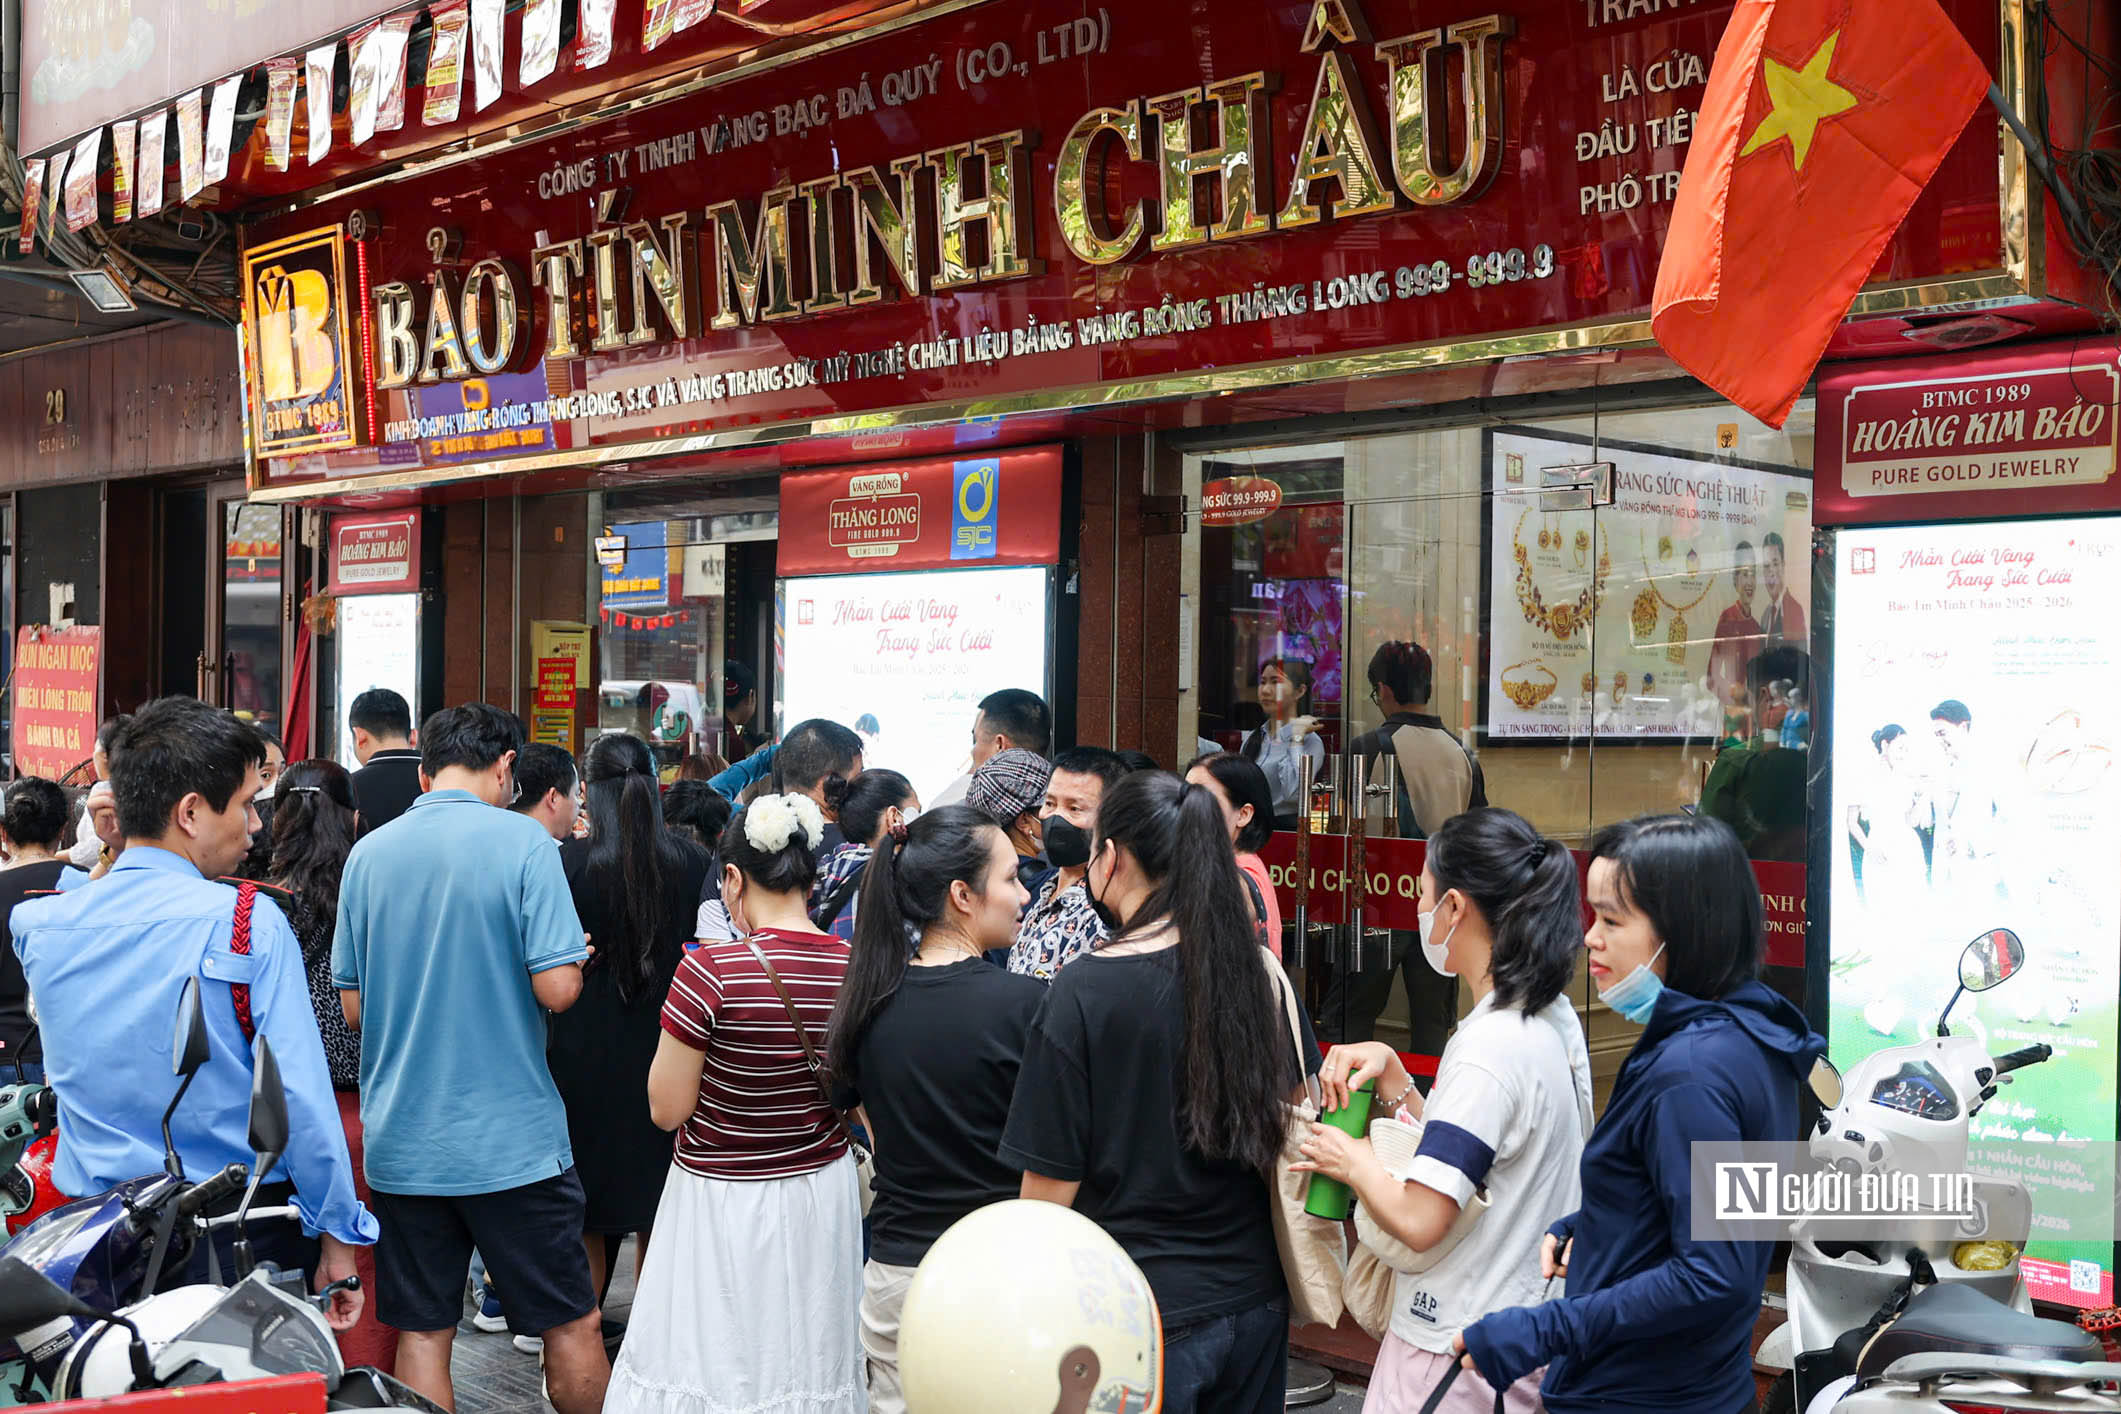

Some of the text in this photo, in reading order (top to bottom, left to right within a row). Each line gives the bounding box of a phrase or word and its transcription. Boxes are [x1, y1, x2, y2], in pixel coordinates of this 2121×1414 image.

[1602, 49, 1706, 104] LÀ CỬA
[538, 158, 596, 200] CÔNG
[602, 149, 631, 183] TY
[635, 131, 696, 173] TNHH
[700, 111, 769, 155] VÀNG
[775, 94, 829, 139] BẠC
[836, 72, 876, 120] ĐÁ
[881, 53, 943, 106] QUÝ
[1037, 7, 1111, 65] LTD)
[1575, 117, 1635, 162] ĐẦU
[372, 0, 1501, 390] BẢO TÍN MINH CHÂU
[1580, 169, 1642, 216] PHỐ
[384, 422, 410, 443] KINH
[411, 414, 454, 439] DOANH
[657, 377, 679, 407] VÀ
[726, 365, 784, 398] TRANG
[854, 341, 906, 380] NGHỆ
[908, 330, 961, 370] CHẤT
[964, 326, 1009, 367] LIỆU
[1012, 313, 1073, 357] BẰNG
[1077, 305, 1140, 347] VÀNG
[1143, 293, 1212, 337] RỒNG
[1216, 281, 1307, 326] THĂNG
[1312, 271, 1390, 313] LONG
[46, 388, 65, 425] 29
[1922, 383, 2032, 409] BTMC 1989
[266, 399, 339, 432] BTMC 1989
[1852, 395, 2106, 453] HOÀNG KIM BẢO
[852, 476, 899, 493] VÀNG RỒNG
[1872, 457, 2080, 485] PURE GOLD JEWELRY
[1202, 495, 1215, 509] NG
[1215, 492, 1232, 508] SỨC
[1656, 471, 1683, 497] SỨC
[1686, 478, 1723, 507] NGHỆ
[1726, 483, 1768, 512] THUẬT
[832, 506, 918, 529] THĂNG LONG
[1226, 510, 1242, 518] GOLD
[1242, 507, 1267, 517] JEWELRY
[1619, 500, 1639, 513] VÀNG
[1686, 508, 1706, 521] LONG
[341, 535, 407, 561] HOÀNG KIM BẢO
[848, 530, 861, 540] FINE
[360, 567, 376, 578] GOLD
[376, 566, 401, 577] JEWELRY
[1946, 569, 1995, 592] Trang
[38, 644, 68, 671] NGAN
[70, 645, 95, 676] MỌC
[40, 683, 66, 711] LÒNG
[67, 685, 93, 719] TRỘN
[66, 723, 81, 751] CÁ
[1509, 723, 1521, 734] TIN
[1521, 723, 1539, 734] SANG
[1540, 723, 1564, 736] TRỌNG
[2025, 1152, 2051, 1171] CẦU
[1413, 1291, 1437, 1312] GAP
